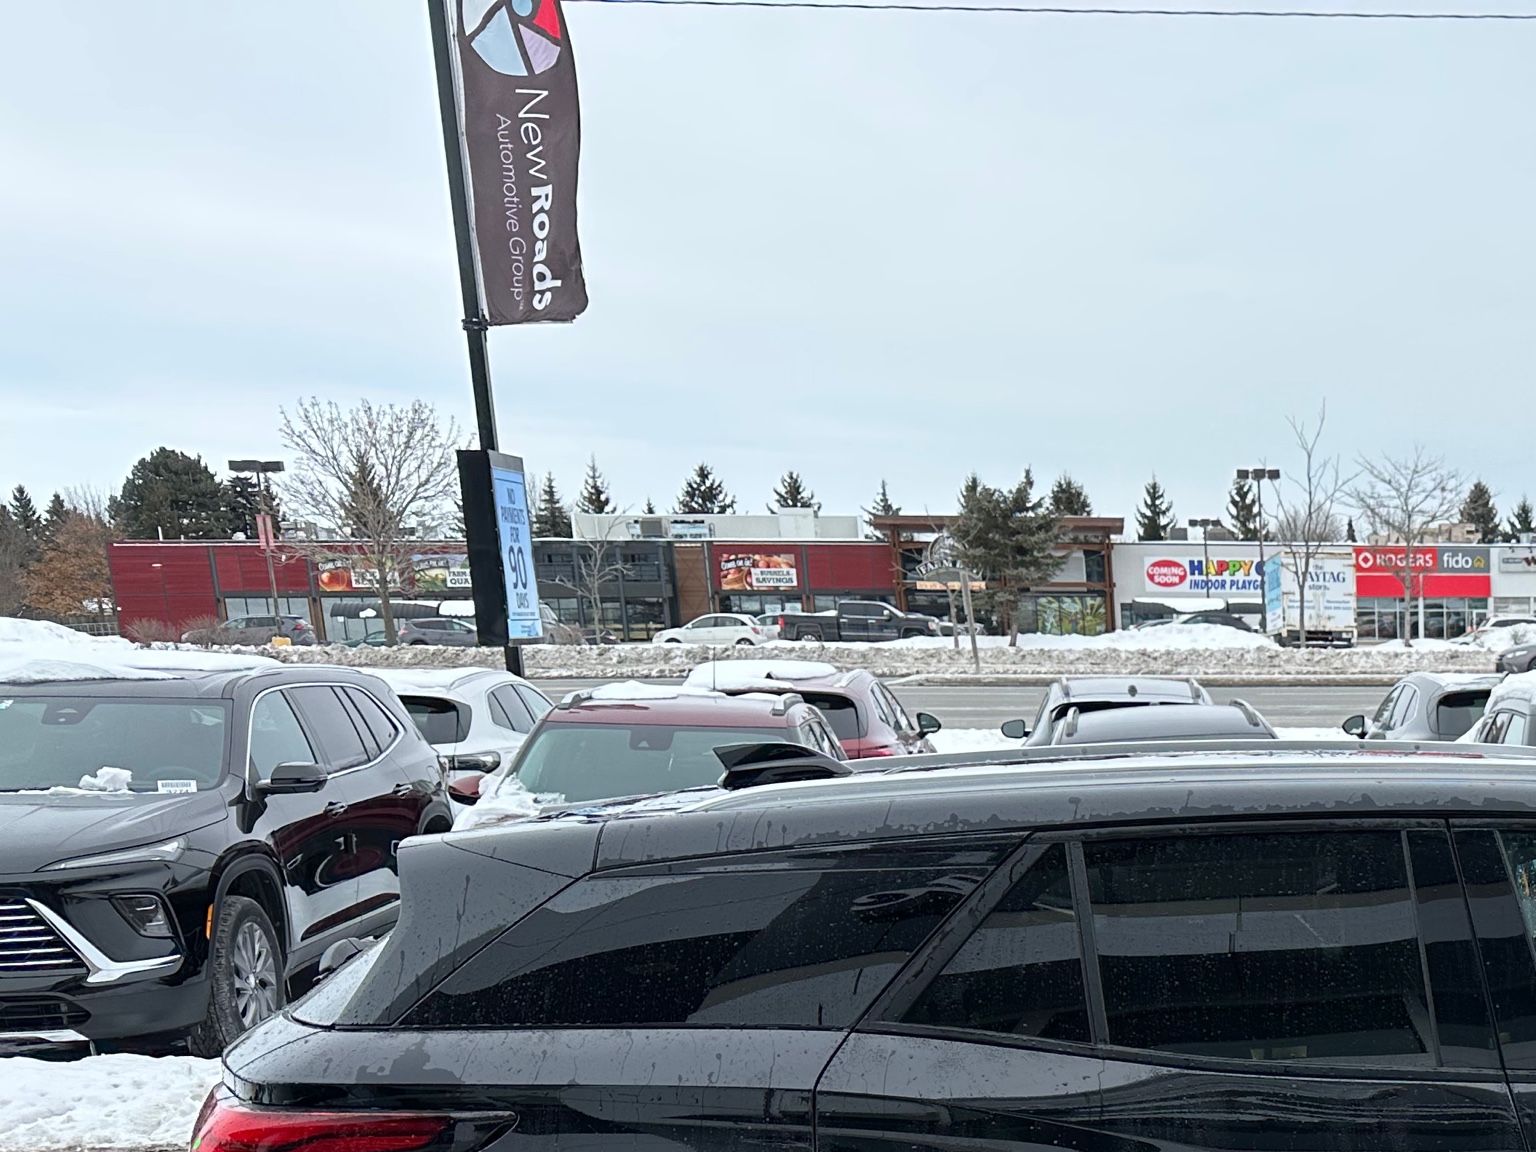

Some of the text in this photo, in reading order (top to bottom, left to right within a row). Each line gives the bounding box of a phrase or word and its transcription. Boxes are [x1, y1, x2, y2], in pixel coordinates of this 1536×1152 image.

[495, 113, 523, 232] Automotive
[506, 487, 516, 505] NO
[500, 505, 526, 525] PAYMENTS
[510, 526, 520, 543] FOR
[508, 545, 528, 590] 90
[1188, 560, 1254, 577] HAPPY
[1376, 553, 1434, 567] ROGERS
[1443, 552, 1472, 569] fido
[1148, 566, 1185, 576] COMING
[1153, 575, 1180, 584] SOON
[1189, 579, 1227, 590] INDOOR
[516, 592, 530, 609] DAYS
